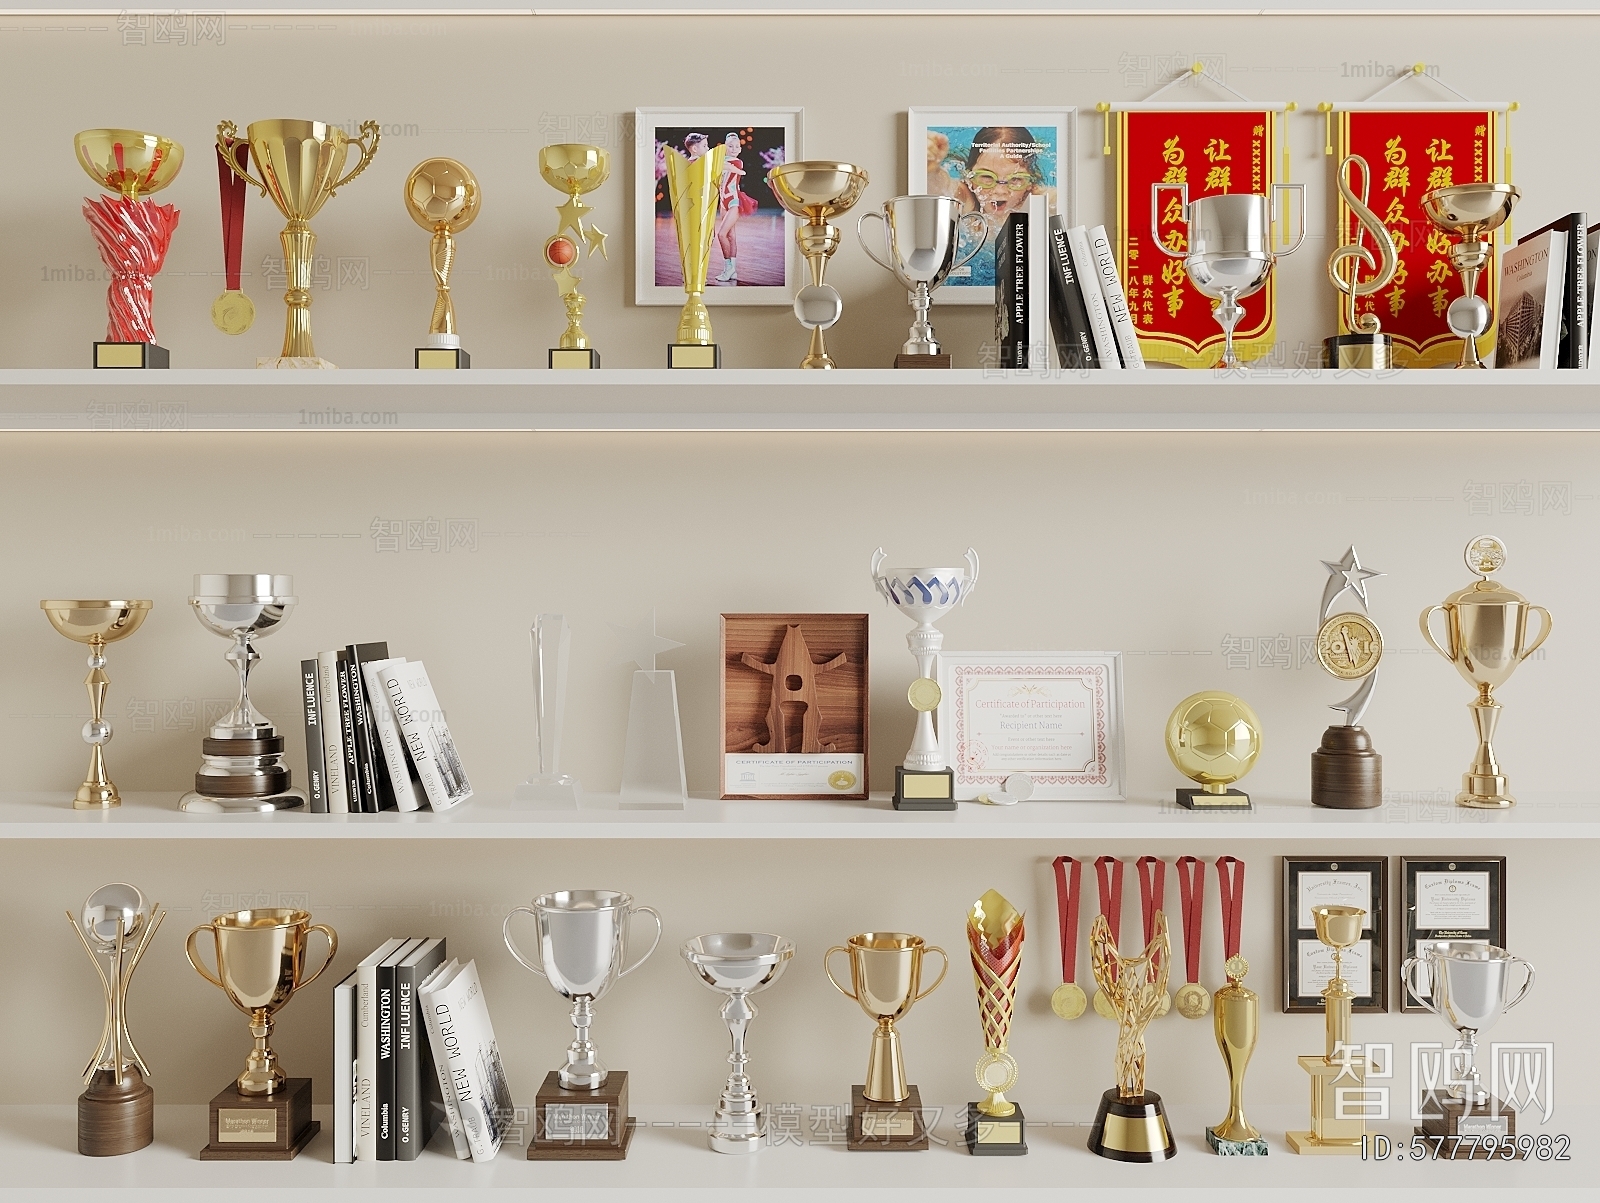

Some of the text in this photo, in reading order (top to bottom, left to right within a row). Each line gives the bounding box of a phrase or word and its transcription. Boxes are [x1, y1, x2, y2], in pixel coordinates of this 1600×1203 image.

[1015, 223, 1024, 325] APPLE TREE FLOWER
[1053, 228, 1074, 285] INFLUENCE
[1094, 238, 1128, 324] NEW WORLD
[1504, 247, 1549, 277] WASHINGTON
[1577, 223, 1585, 328] APPLE TREE FLOWER
[1091, 293, 1112, 358] WASHINGTON
[304, 672, 317, 727] INFLUENCE
[322, 664, 331, 703] Cumberland
[350, 664, 364, 726] WASHINGTON
[975, 699, 1085, 710] Certificate of Participation
[340, 670, 355, 765] APPLE TREE FLOWER
[386, 678, 427, 762] NEW WORLD
[1000, 721, 1063, 731] Recipient Name
[330, 743, 340, 795] VINELAND
[364, 762, 372, 795] Columbia
[383, 728, 406, 794] WASHINGTON
[361, 983, 369, 1028] Cumberland
[380, 988, 391, 1060] WASHINGTON
[400, 982, 411, 1050] INFLUENCE
[435, 1003, 473, 1102] NEW WORLD
[360, 1078, 371, 1138] VINELAND
[438, 1064, 460, 1138] WASHINGTON
